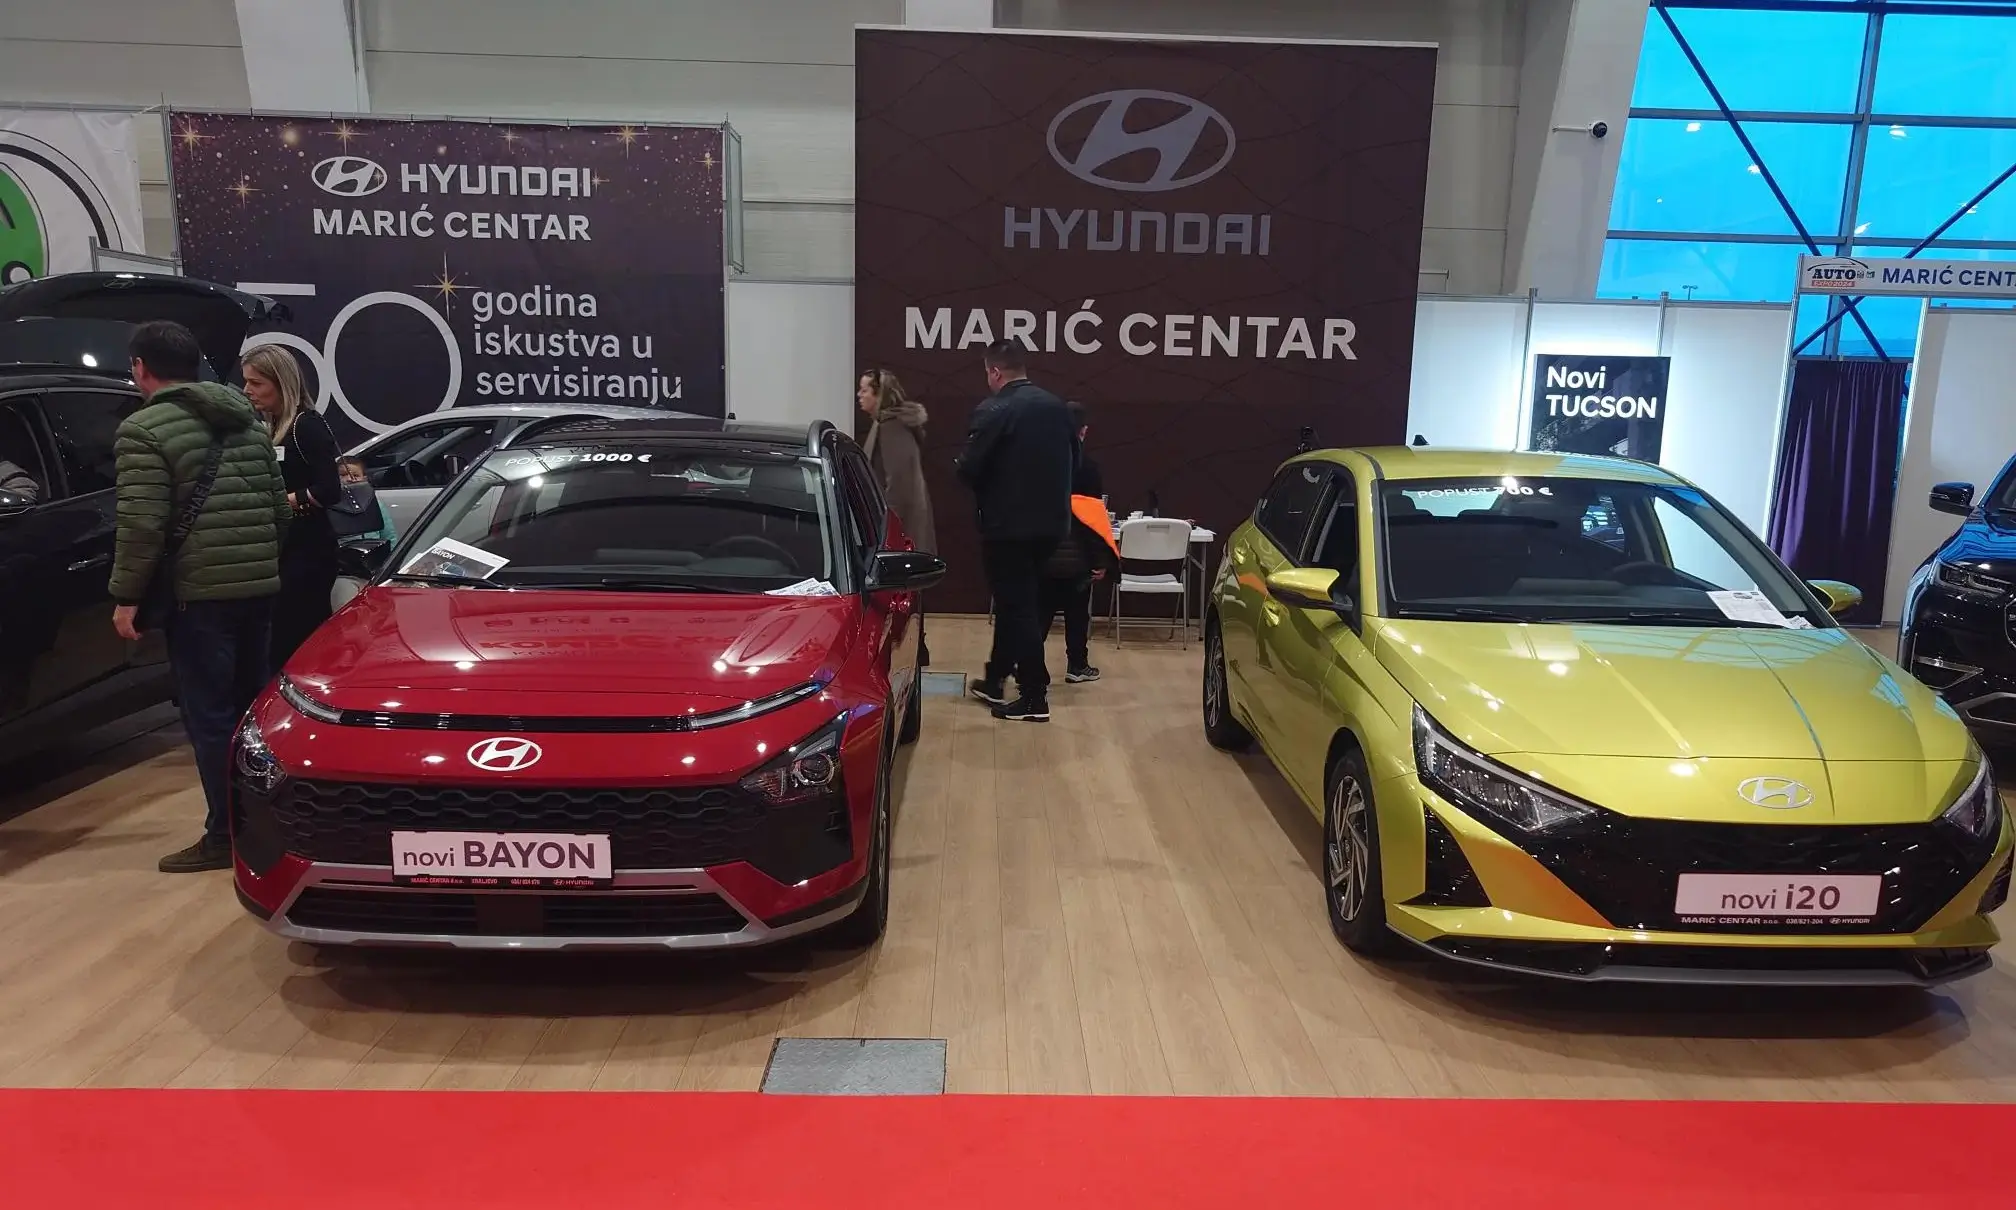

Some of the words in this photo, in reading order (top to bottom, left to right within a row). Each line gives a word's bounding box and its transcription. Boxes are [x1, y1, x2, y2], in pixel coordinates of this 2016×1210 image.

[401, 163, 592, 198] HYUNDAI
[313, 204, 434, 236] MARIĆ
[444, 211, 592, 241] CENTAR
[1004, 206, 1271, 255] HYUNDAI
[1812, 269, 1856, 280] AUTO
[1882, 265, 1952, 285] MARIĆ
[1958, 269, 2016, 287] CENT
[472, 284, 597, 322] godina
[474, 323, 620, 358] iskustva
[632, 335, 653, 359] u
[905, 299, 1104, 354] MARIĆ
[1119, 312, 1358, 360] CENTAR
[475, 366, 683, 406] servisiranju
[1546, 365, 1606, 389] Novi
[1546, 394, 1656, 419] TUCSON
[505, 455, 579, 466] POPUST
[580, 453, 633, 462] 1000
[637, 454, 652, 463] €
[1417, 487, 1491, 499] POPUST
[1538, 487, 1553, 496] €
[403, 847, 454, 867] novi
[463, 841, 595, 869] BAYON
[1721, 889, 1777, 910] novi
[1785, 884, 1841, 911] i20
[1719, 917, 1761, 925] CENTAR
